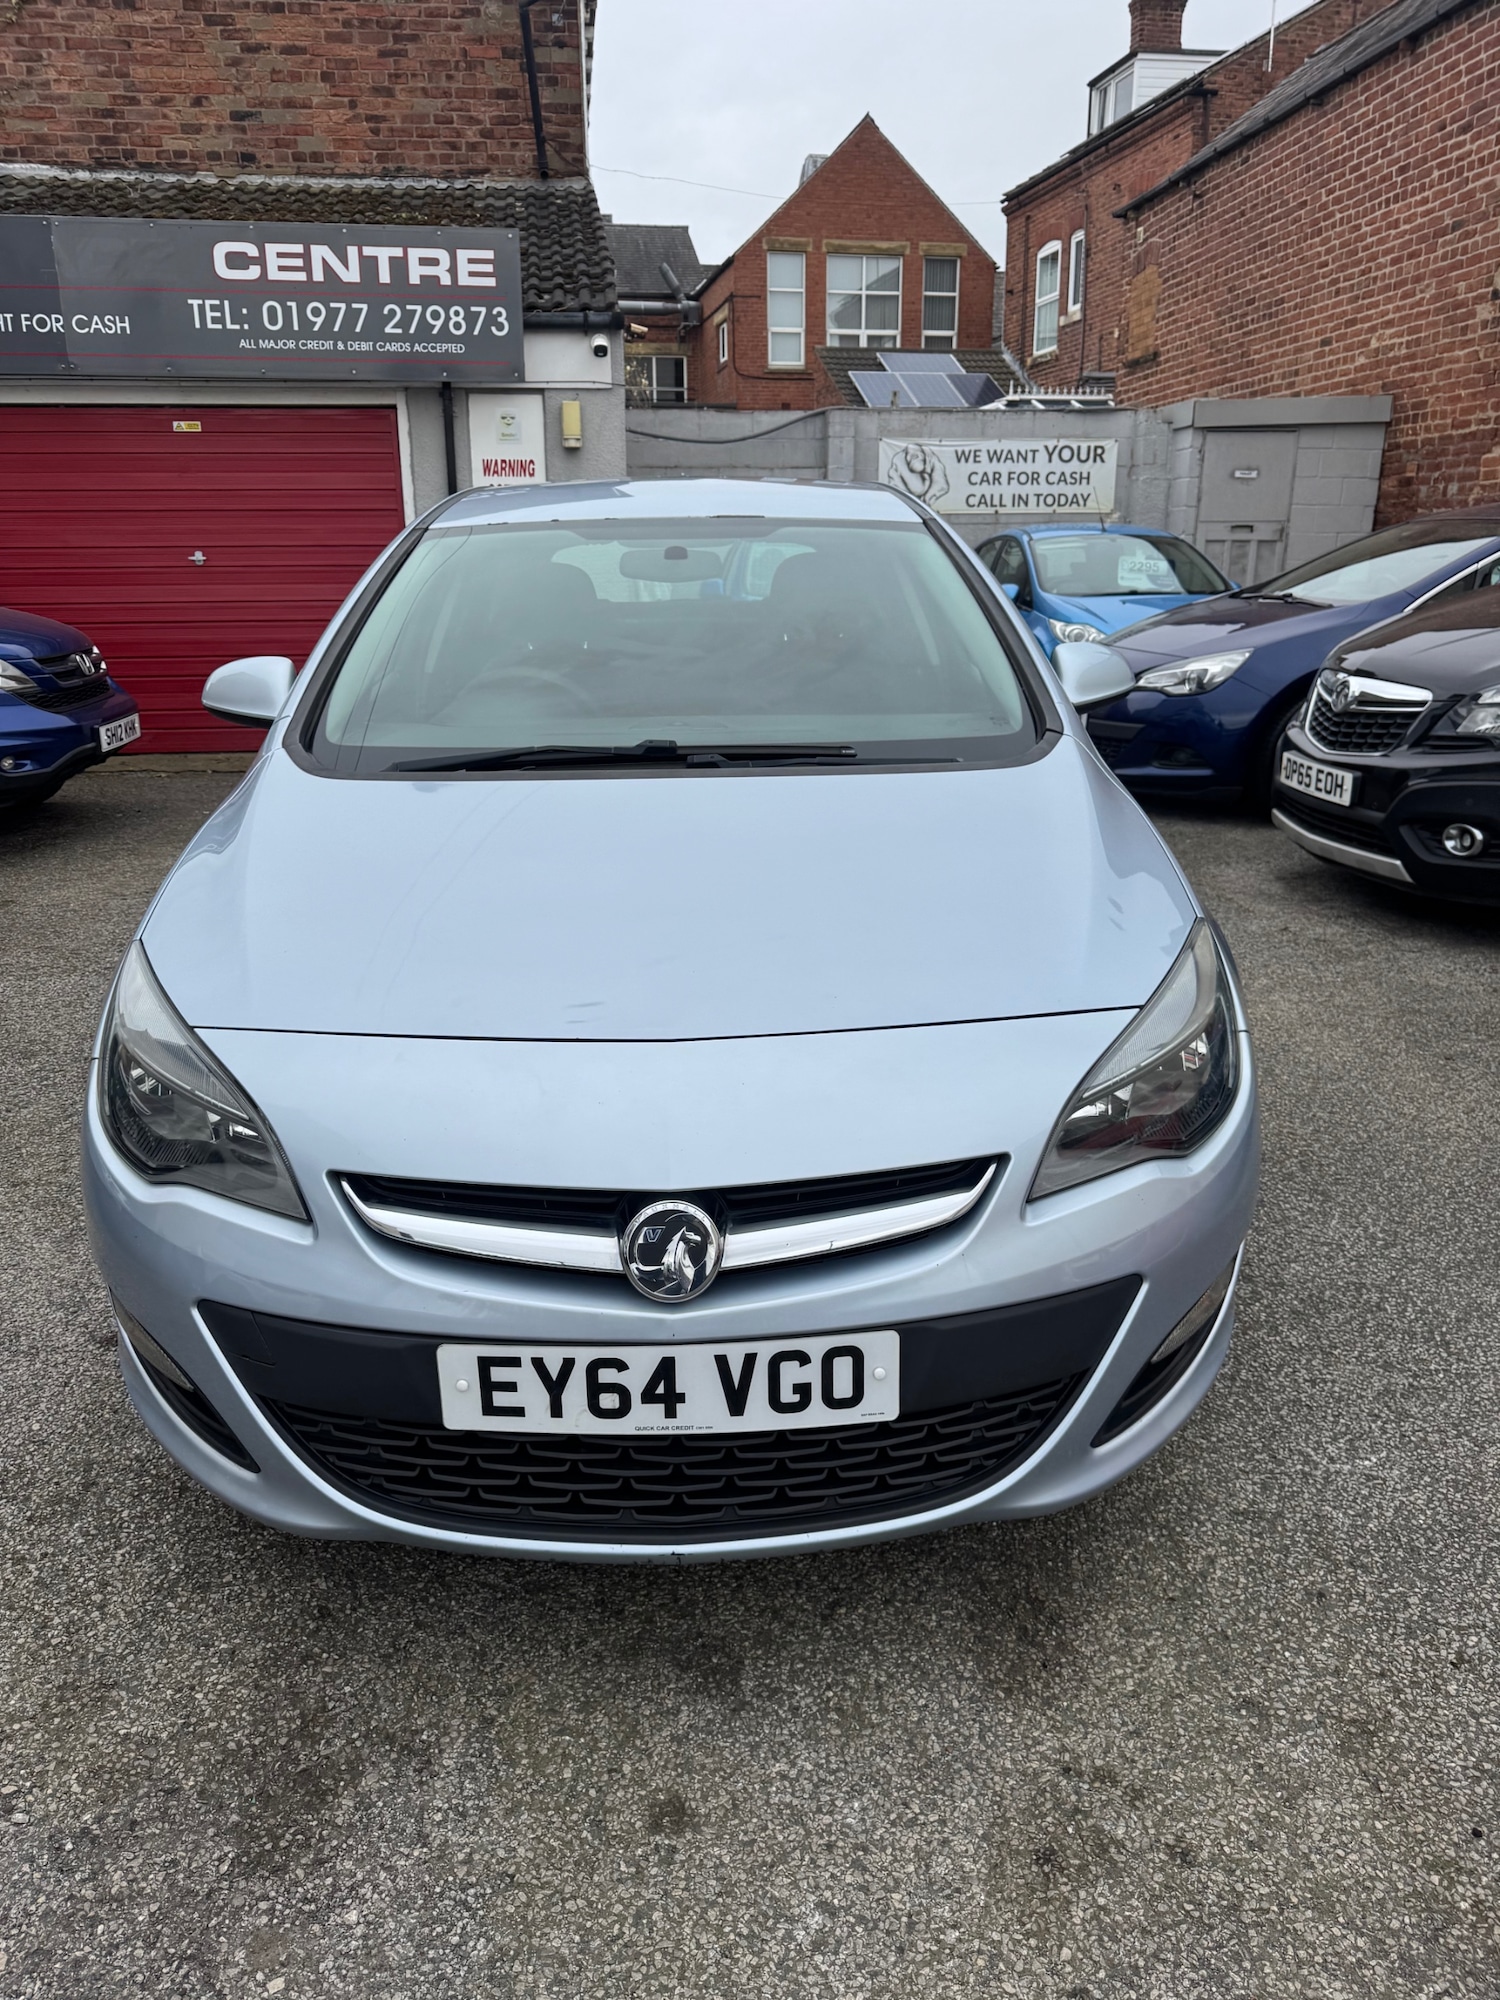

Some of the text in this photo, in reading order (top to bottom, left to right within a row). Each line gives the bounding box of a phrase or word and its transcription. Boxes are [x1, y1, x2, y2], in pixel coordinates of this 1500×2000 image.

[213, 241, 497, 288] CENTRE
[20, 313, 65, 333] FOR
[71, 314, 131, 335] CASH
[187, 298, 510, 337] TEL: 01977 279873
[239, 338, 466, 354] ALL MAJOR CREDIT & DEBIT CARDS ACCEPTED
[954, 444, 1106, 464] WE WANT YOUR
[482, 458, 536, 478] WARNING
[967, 471, 1091, 486] CAR FOR CASH
[965, 492, 1091, 508] CALL IN TODAY
[1284, 757, 1344, 798] DP65 EOH
[477, 1344, 865, 1419] EY64 VGO
